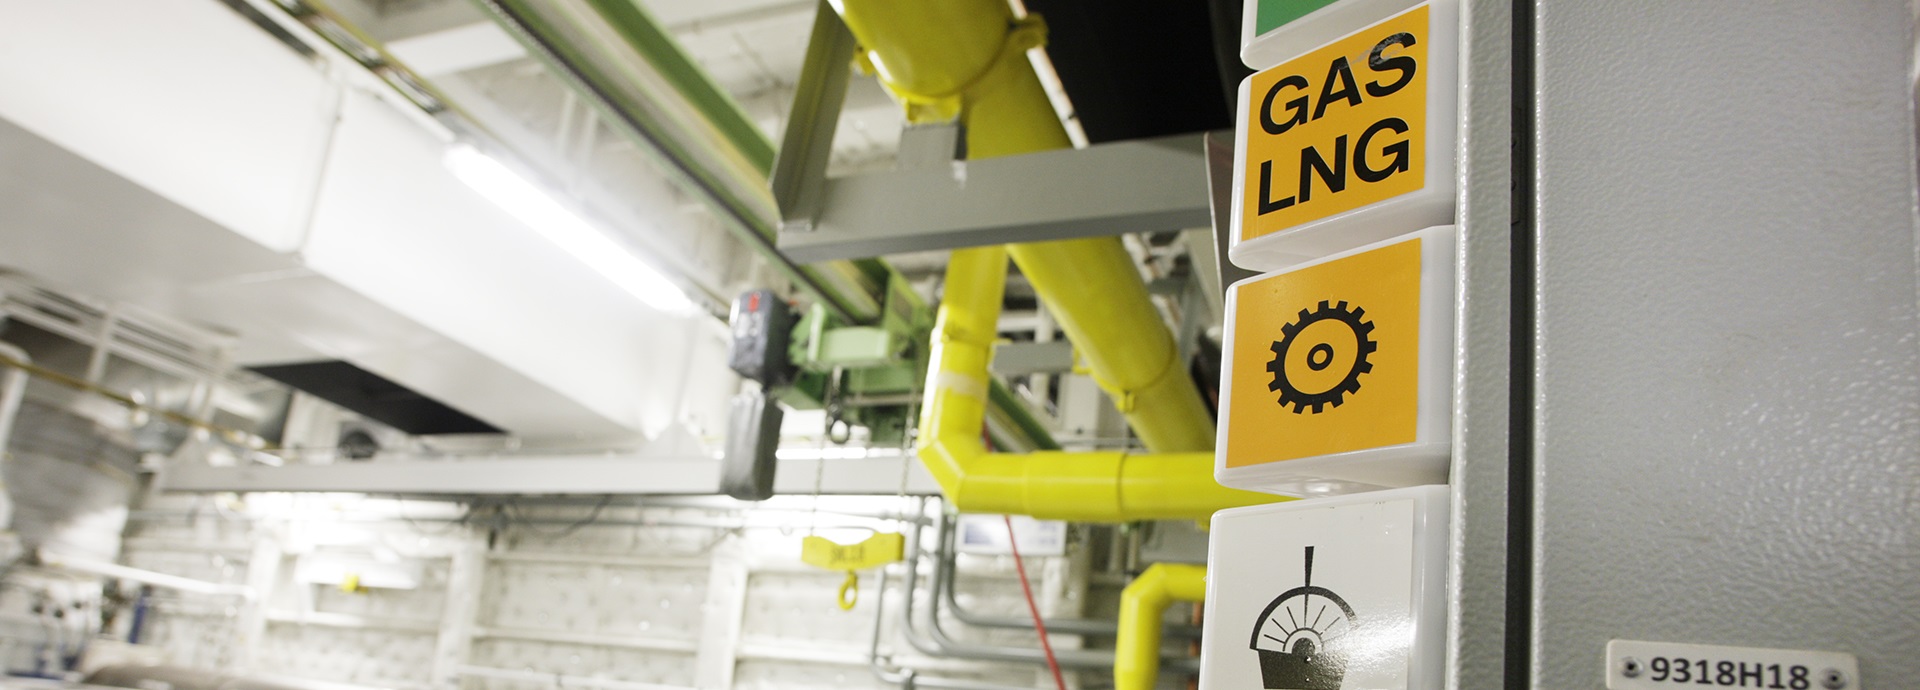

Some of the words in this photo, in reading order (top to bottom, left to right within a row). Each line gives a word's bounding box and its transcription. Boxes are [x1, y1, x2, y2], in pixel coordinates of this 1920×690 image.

[1260, 32, 1416, 135] GAS
[1258, 117, 1410, 216] LNG
[1651, 657, 1810, 690] 9318H18
